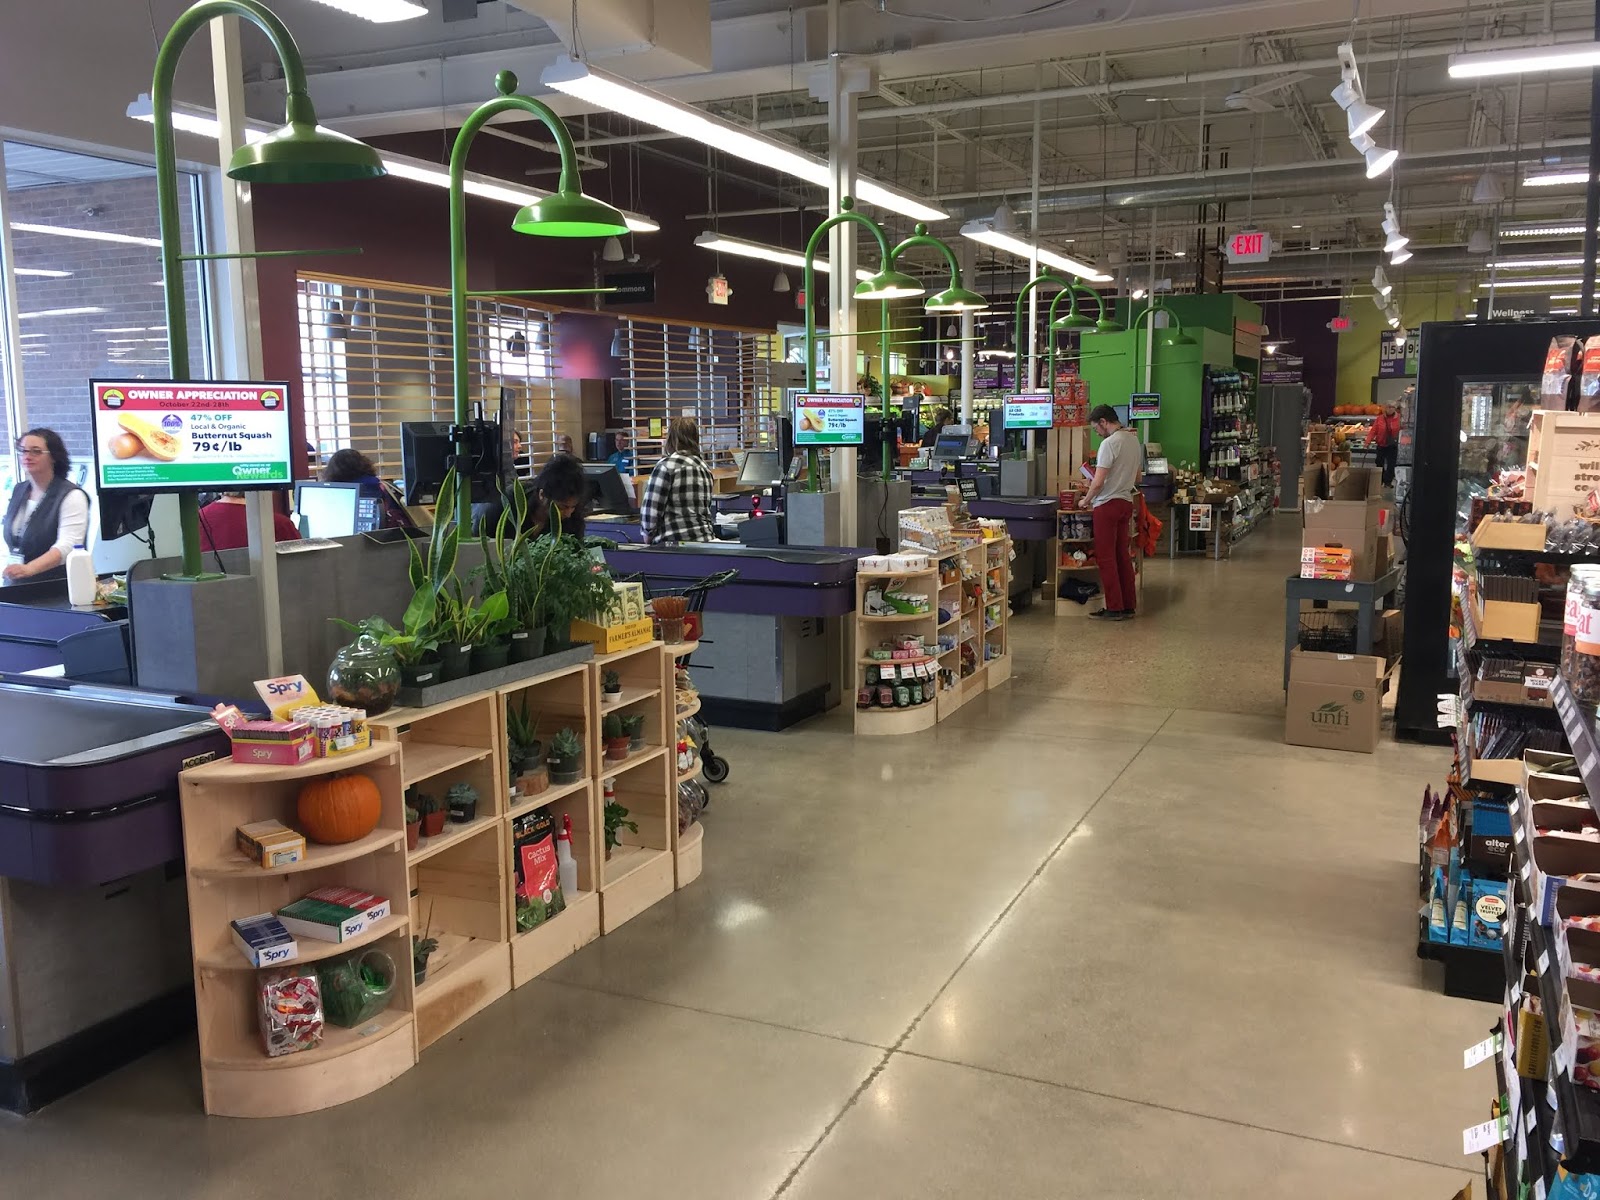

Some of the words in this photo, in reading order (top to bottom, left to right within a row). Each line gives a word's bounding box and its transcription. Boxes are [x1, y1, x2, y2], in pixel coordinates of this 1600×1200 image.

[1236, 234, 1264, 255] EXIT
[128, 389, 174, 400] OWNER
[176, 389, 257, 401] APPRECIATION
[218, 423, 246, 431] Organic
[191, 432, 238, 440] Butternut
[239, 432, 272, 441] Squash
[231, 465, 271, 475] Owner
[609, 631, 631, 644] FARMER'S
[631, 625, 652, 638] ALMANAC
[266, 680, 302, 695] Spry
[1310, 709, 1349, 727] unfi
[183, 752, 215, 769] ACCENT
[252, 749, 272, 759] Spry
[515, 826, 535, 839] BLACK
[536, 820, 551, 830] GOLD
[1485, 839, 1510, 848] alter
[527, 845, 551, 860] Cactus
[533, 854, 547, 865] Mix
[369, 907, 385, 920] Spry
[1480, 904, 1502, 912] VELVET
[345, 922, 363, 935] Spry
[265, 948, 290, 961] Spry
